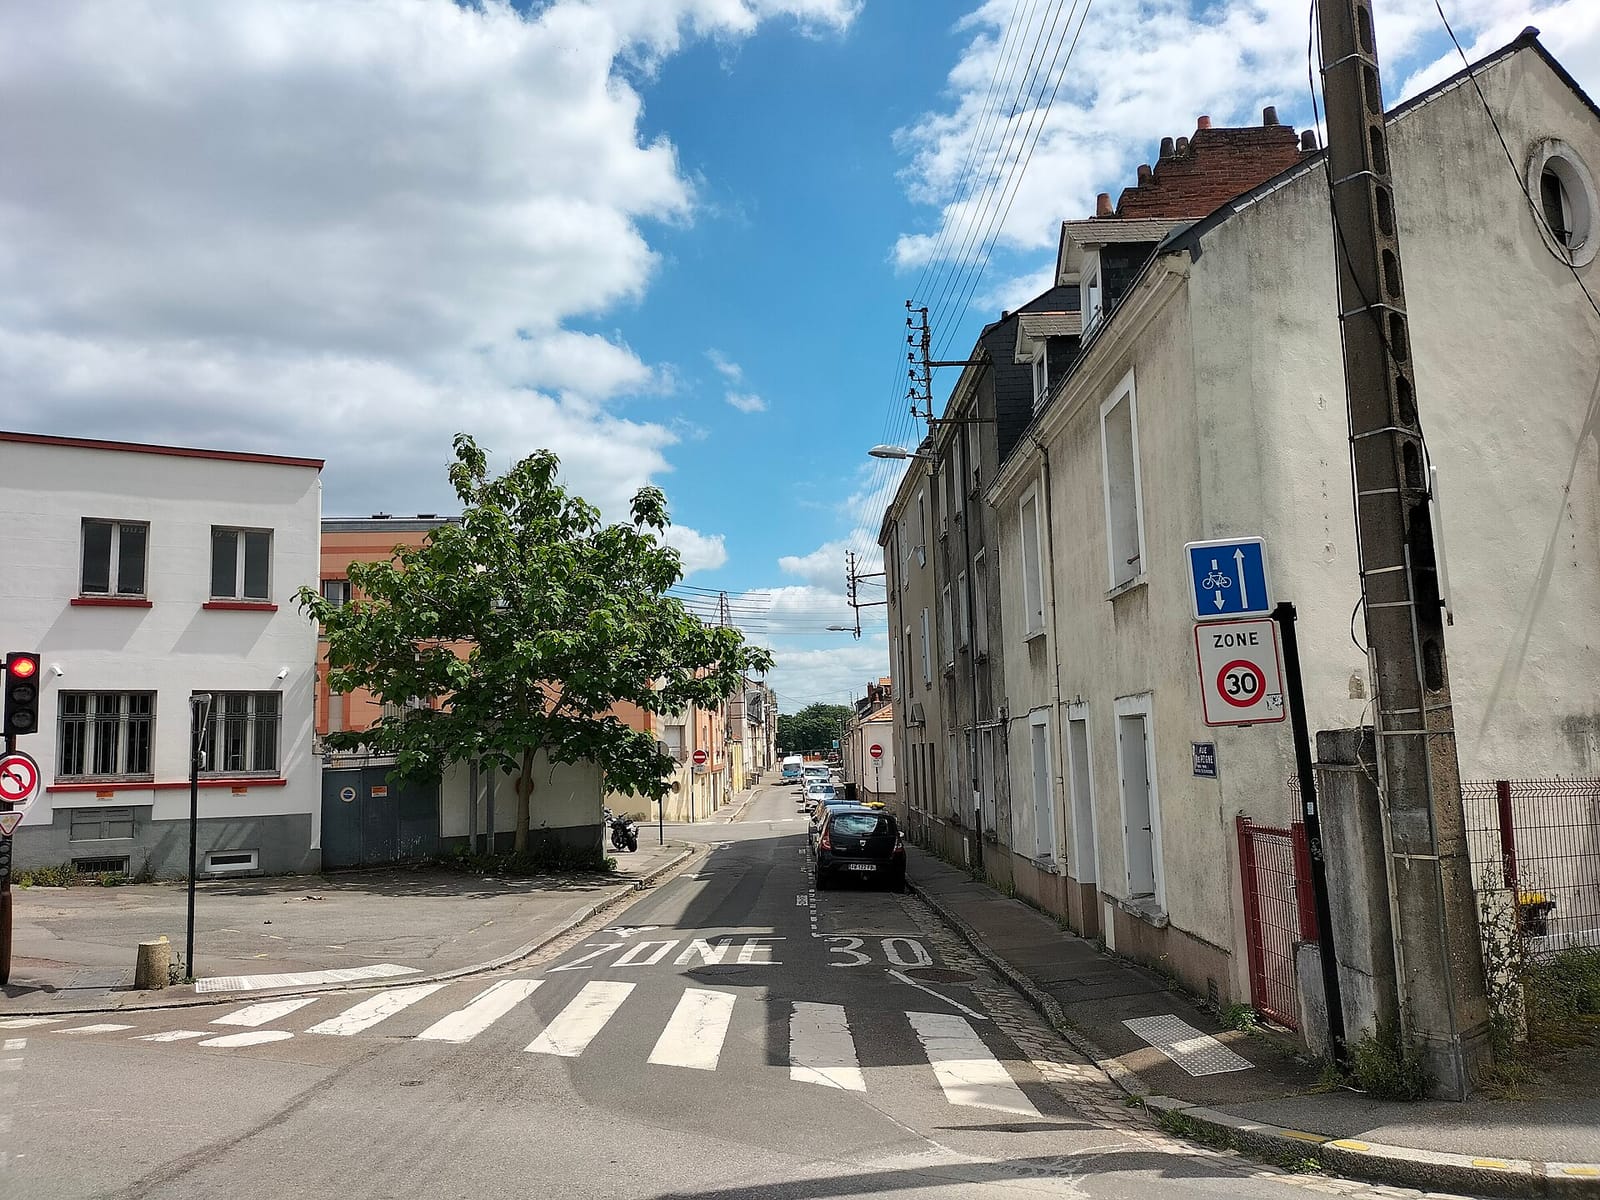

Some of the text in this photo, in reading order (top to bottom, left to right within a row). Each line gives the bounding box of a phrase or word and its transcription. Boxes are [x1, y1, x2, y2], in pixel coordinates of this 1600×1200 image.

[1213, 632, 1259, 648] ZONE
[1226, 672, 1257, 695] 30
[546, 936, 934, 973] ZONE 30
